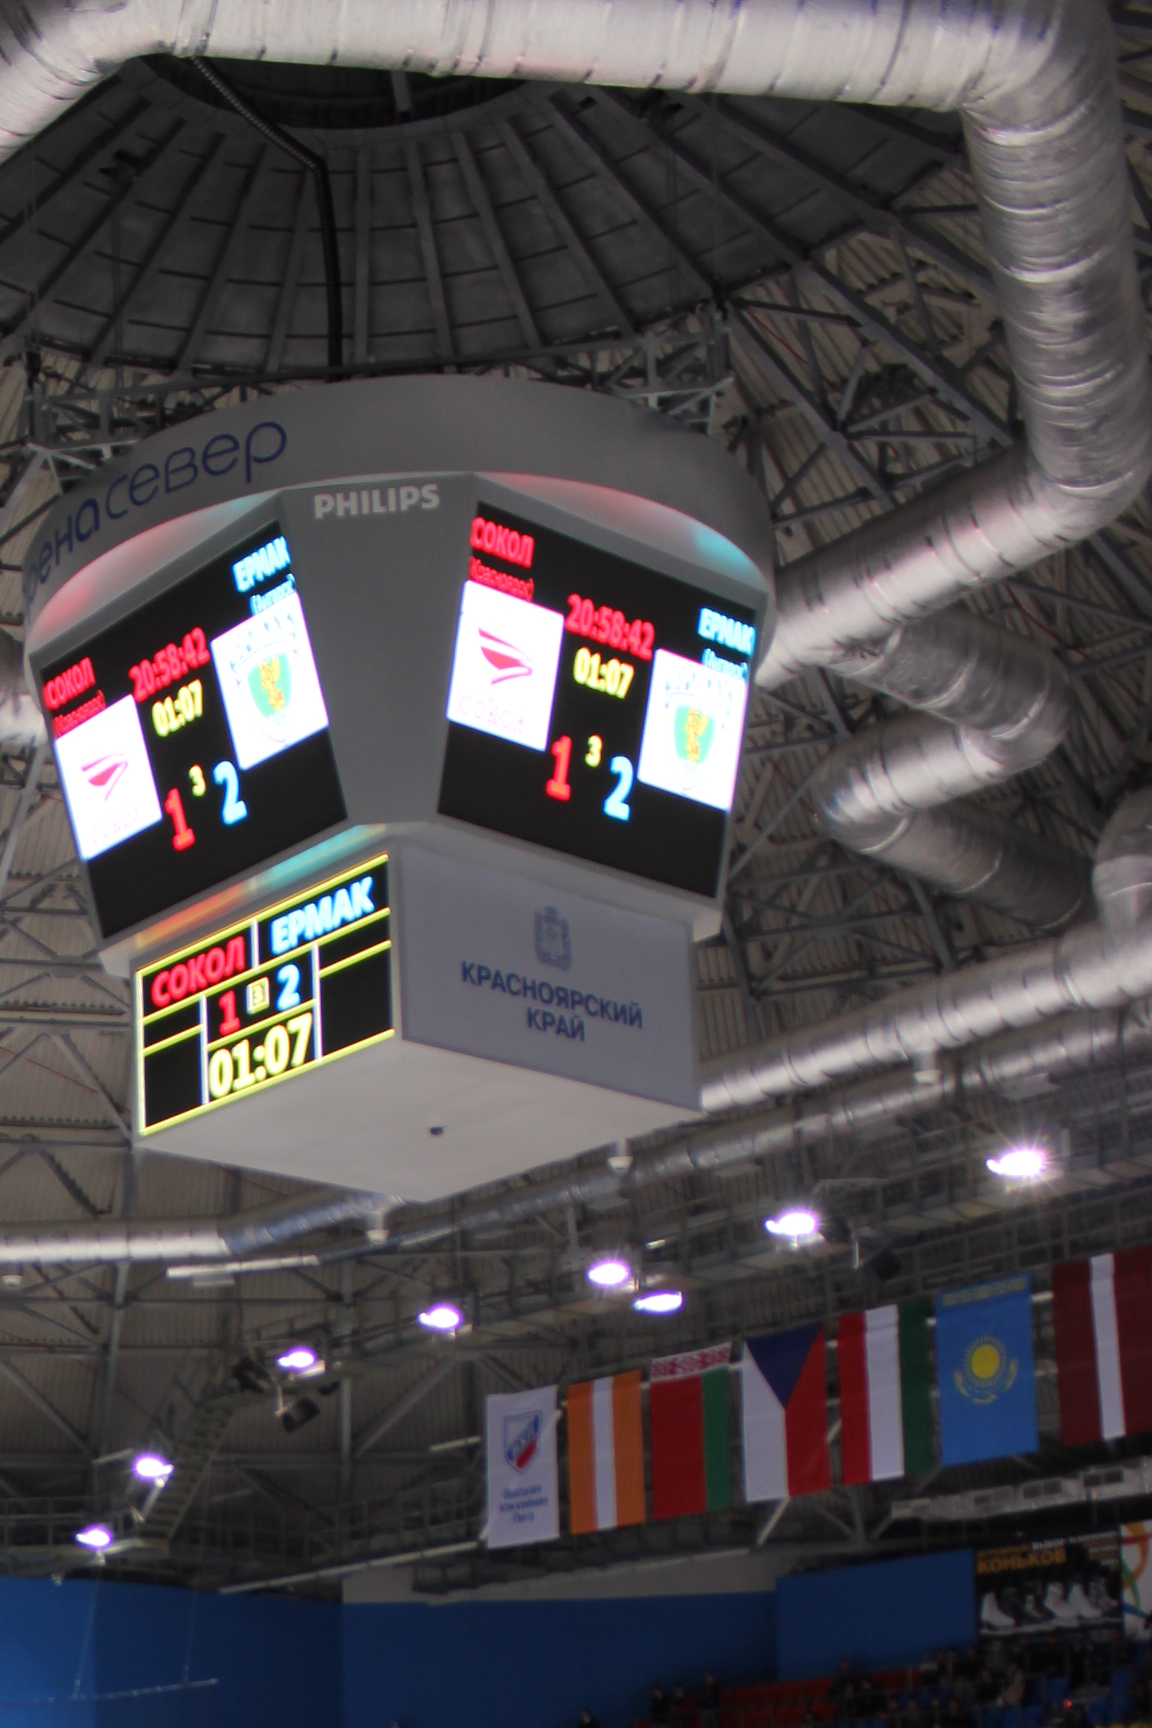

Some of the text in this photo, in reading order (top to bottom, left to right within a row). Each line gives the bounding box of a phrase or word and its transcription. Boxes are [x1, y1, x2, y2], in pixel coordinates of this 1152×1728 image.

[314, 483, 440, 519] PHILIPS
[232, 535, 292, 593] ЕРМАК
[470, 516, 535, 569] СОКОЛ
[565, 592, 655, 662] 20:58:42
[698, 607, 756, 656] ЕРМАК
[43, 657, 96, 710] СОКОЛ
[128, 627, 211, 703] 20:58:42
[573, 647, 634, 699] 01:07
[151, 679, 203, 737] 01:07
[165, 760, 248, 852] 1 3 2
[546, 734, 634, 821] 1 3 2
[150, 876, 375, 1007] СОКОЛ ЕРМАК
[218, 963, 301, 1036] 1 3 2
[461, 960, 644, 1030] КРАСНОЯРСКИЙ
[527, 1006, 586, 1042] КРАЙ
[208, 1011, 313, 1098] 01:07
[977, 1549, 1067, 1575] КОНЬКОВ
